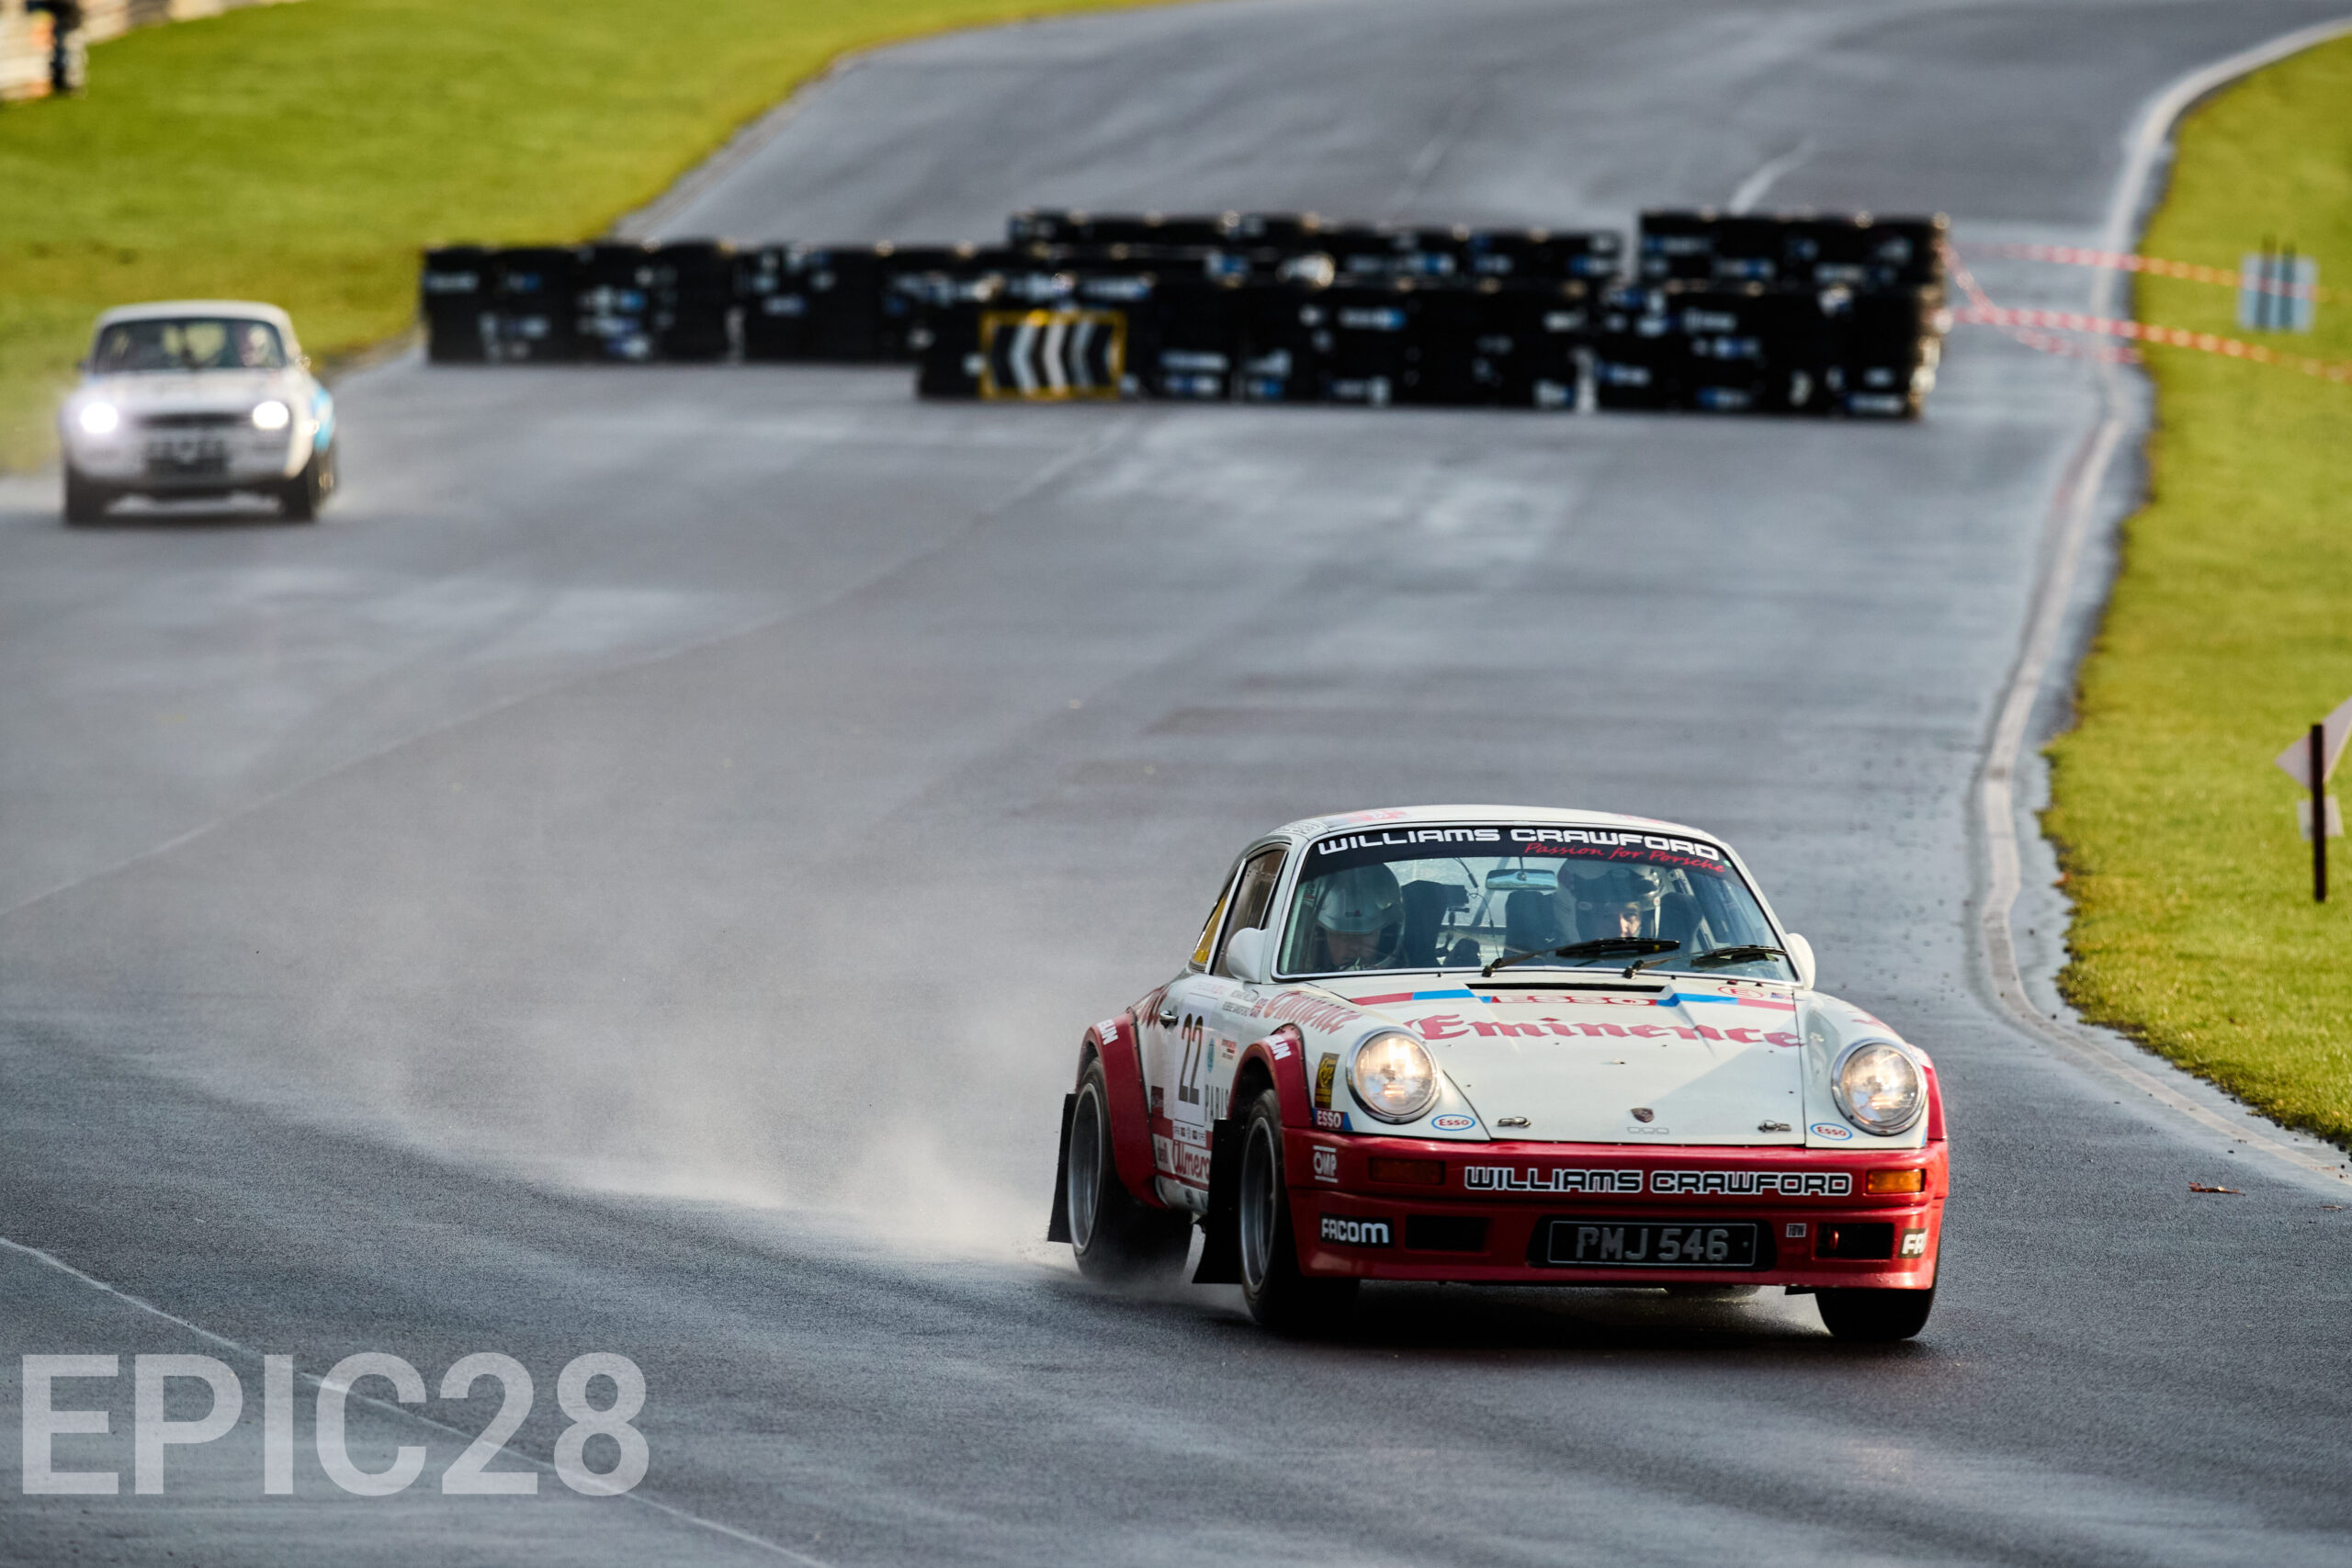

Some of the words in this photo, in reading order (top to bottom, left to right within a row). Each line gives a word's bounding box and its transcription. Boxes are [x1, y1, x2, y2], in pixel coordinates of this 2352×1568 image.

[1317, 829, 1500, 855] WILLIAMS
[1510, 829, 1719, 861] CRAWFORD
[1524, 842, 1604, 855] Passion
[1608, 847, 1644, 860] for
[1648, 851, 1726, 873] Porsche
[1497, 996, 1650, 1006] ESSO
[1404, 1014, 1806, 1047] Eminence
[1179, 1013, 1204, 1105] 22
[1316, 1111, 1342, 1128] ESSO
[1313, 1152, 1338, 1177] OMP
[1464, 1167, 1643, 1193] WILLIAMS
[1650, 1170, 1852, 1196] CRAWFORD
[1577, 1227, 1648, 1260] PMJ
[1658, 1228, 1729, 1261] 546
